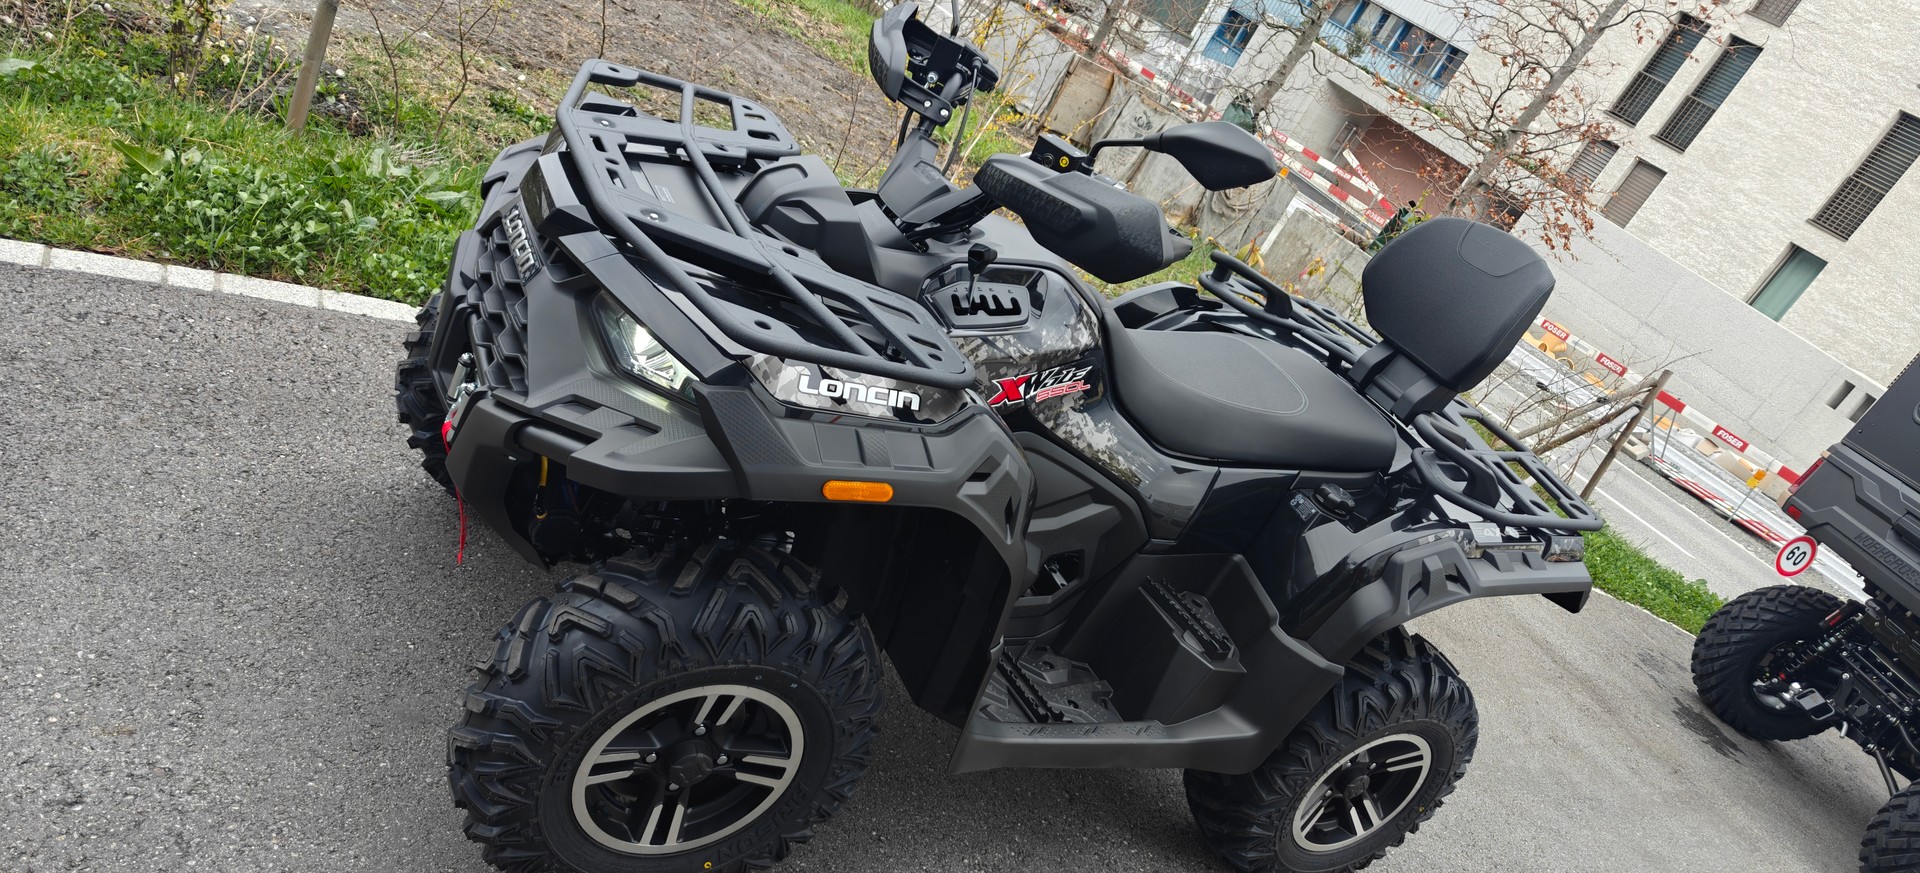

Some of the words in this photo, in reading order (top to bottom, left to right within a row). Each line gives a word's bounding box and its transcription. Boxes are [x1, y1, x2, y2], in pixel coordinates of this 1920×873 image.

[1365, 209, 1385, 225] FOSER
[1542, 321, 1568, 339] FOSER
[1600, 356, 1624, 373] FOSER
[794, 365, 920, 411] LONCIN
[1716, 429, 1744, 449] FOSER
[1785, 546, 1807, 566] 60
